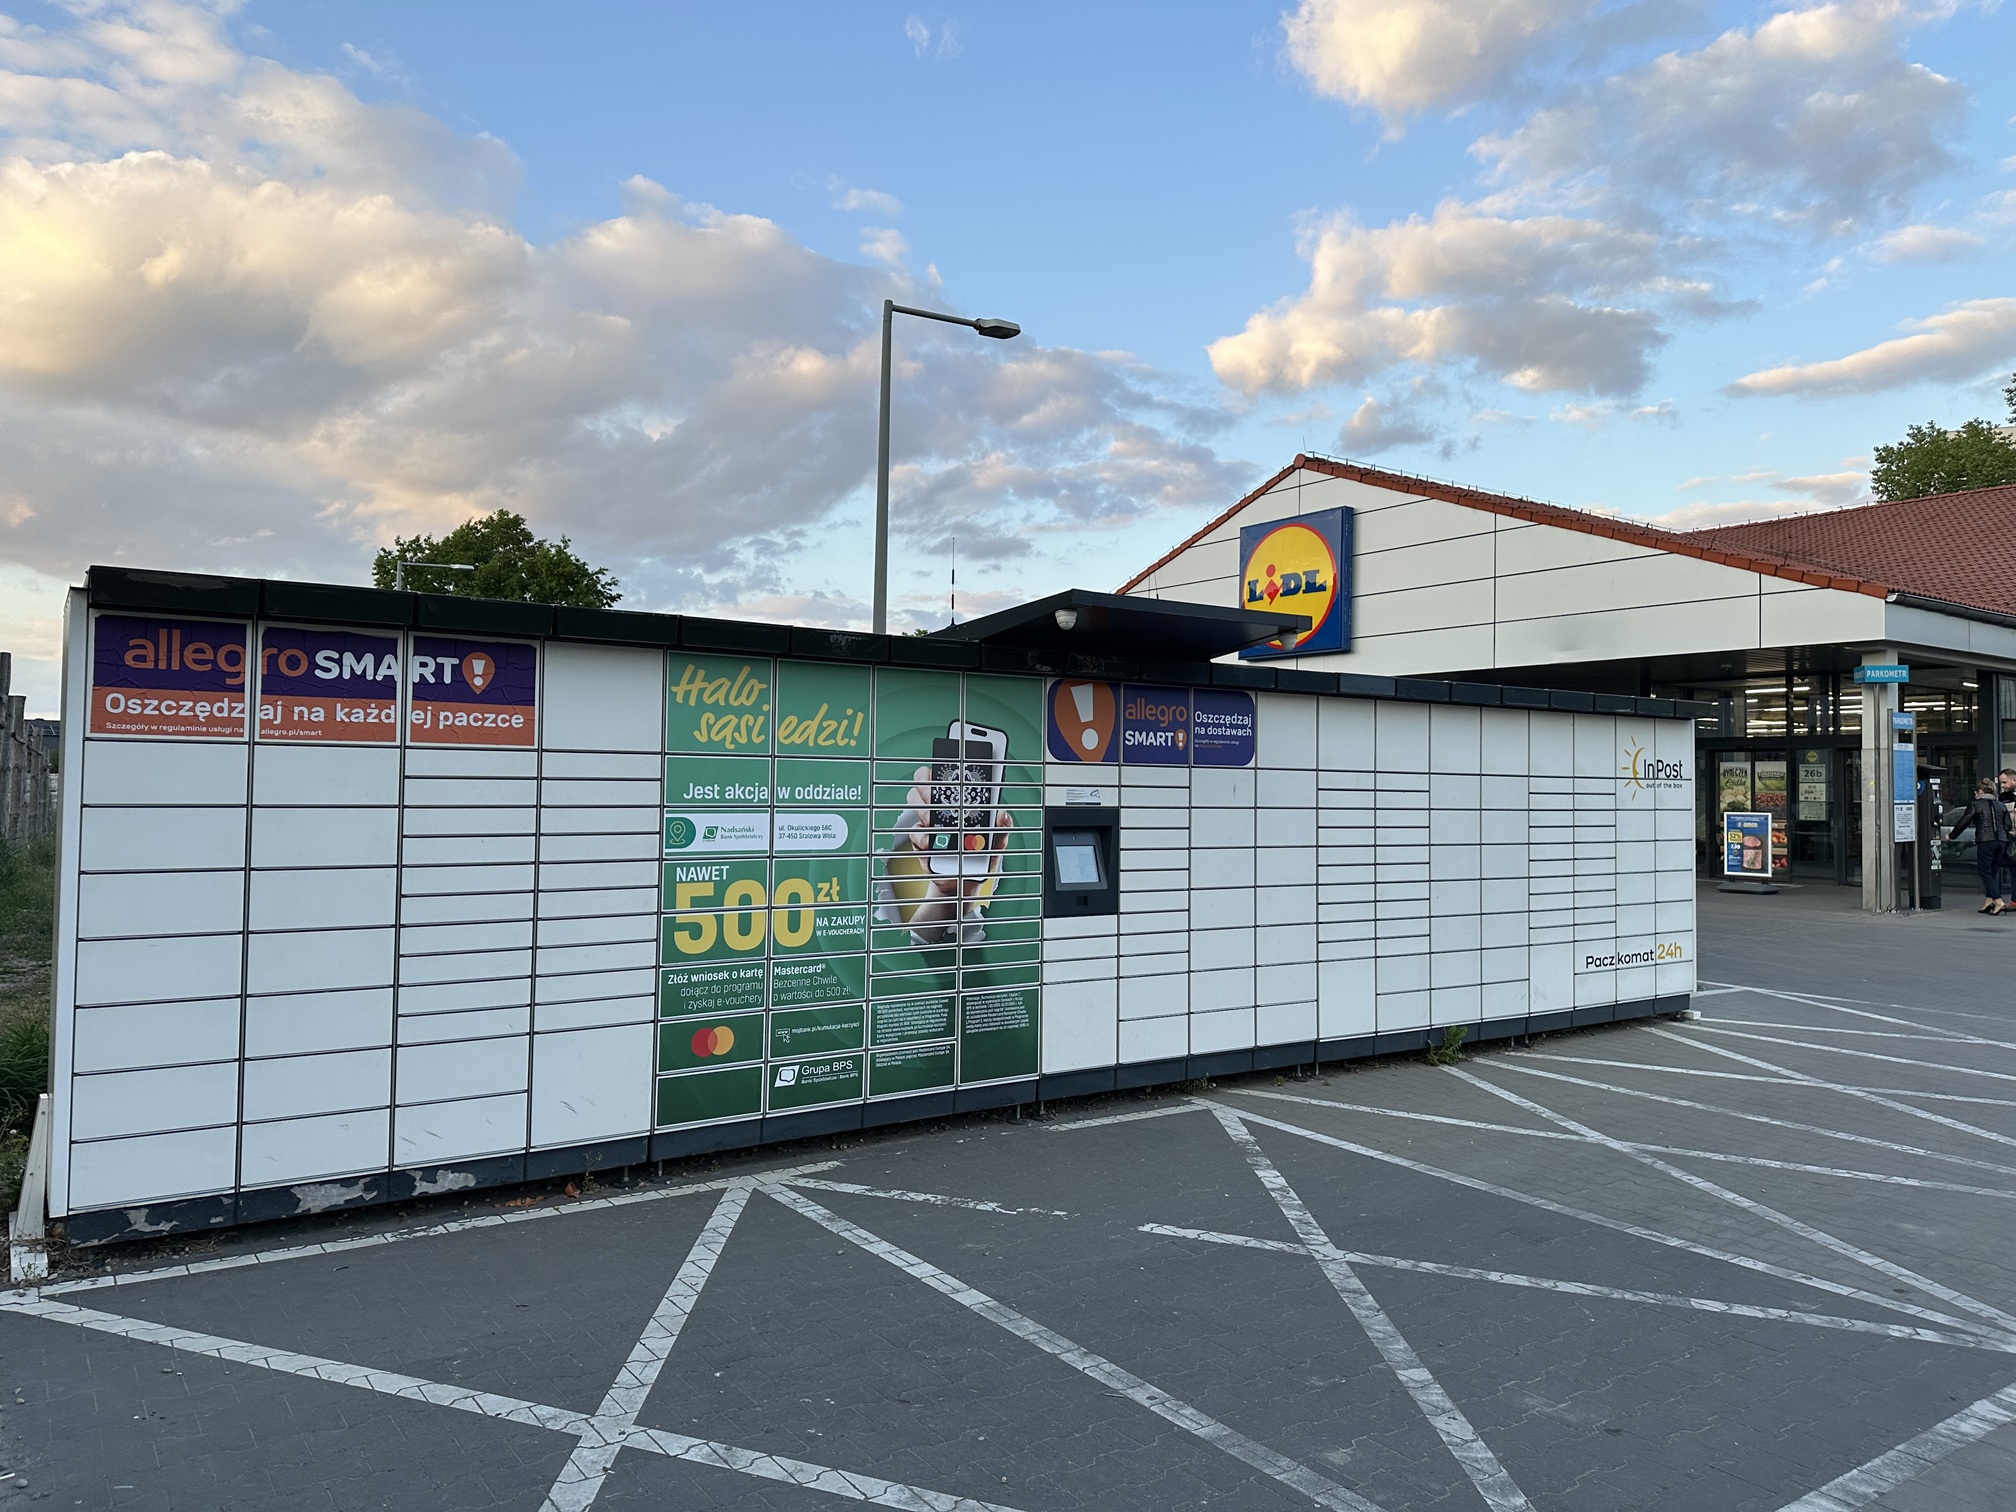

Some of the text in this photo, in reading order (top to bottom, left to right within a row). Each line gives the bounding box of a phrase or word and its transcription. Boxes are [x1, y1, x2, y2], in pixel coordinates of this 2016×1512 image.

[123, 628, 309, 685] allegro
[1866, 669, 1907, 678] PARKOMETR
[671, 664, 768, 706] Halo
[293, 704, 325, 722] na
[438, 710, 524, 729] paczce
[1125, 697, 1188, 727] allegro
[1194, 711, 1252, 727] Oszczędzaj
[105, 721, 150, 732] Szczegóły
[159, 723, 207, 733] regulaminie
[208, 725, 231, 735] usługi
[260, 728, 322, 736] allegro.pl/smart
[1194, 725, 1252, 736] na dostawach
[1643, 758, 1683, 779] InPost
[1803, 769, 1823, 778] 26b
[683, 782, 862, 802] Jest akcja w oddziale!
[676, 865, 730, 882] NAWET
[673, 876, 841, 955] 500 zł
[816, 914, 866, 927] NA ZAKUPY
[816, 927, 865, 937] W E-VOUCHERACH
[1585, 942, 1683, 969] Paczkomat 24h
[667, 967, 763, 985] Złóż wniosek o kartę
[773, 974, 837, 989] Bezcenne Chwile
[680, 981, 763, 998] dołącz do programu
[773, 994, 779, 1002] o
[780, 989, 813, 1001] wartości
[814, 988, 825, 998] do
[826, 986, 840, 997] 500
[688, 998, 715, 1011] zyskaj
[716, 993, 763, 1007] e-vouchery
[801, 1060, 853, 1076] Grupa BPS
